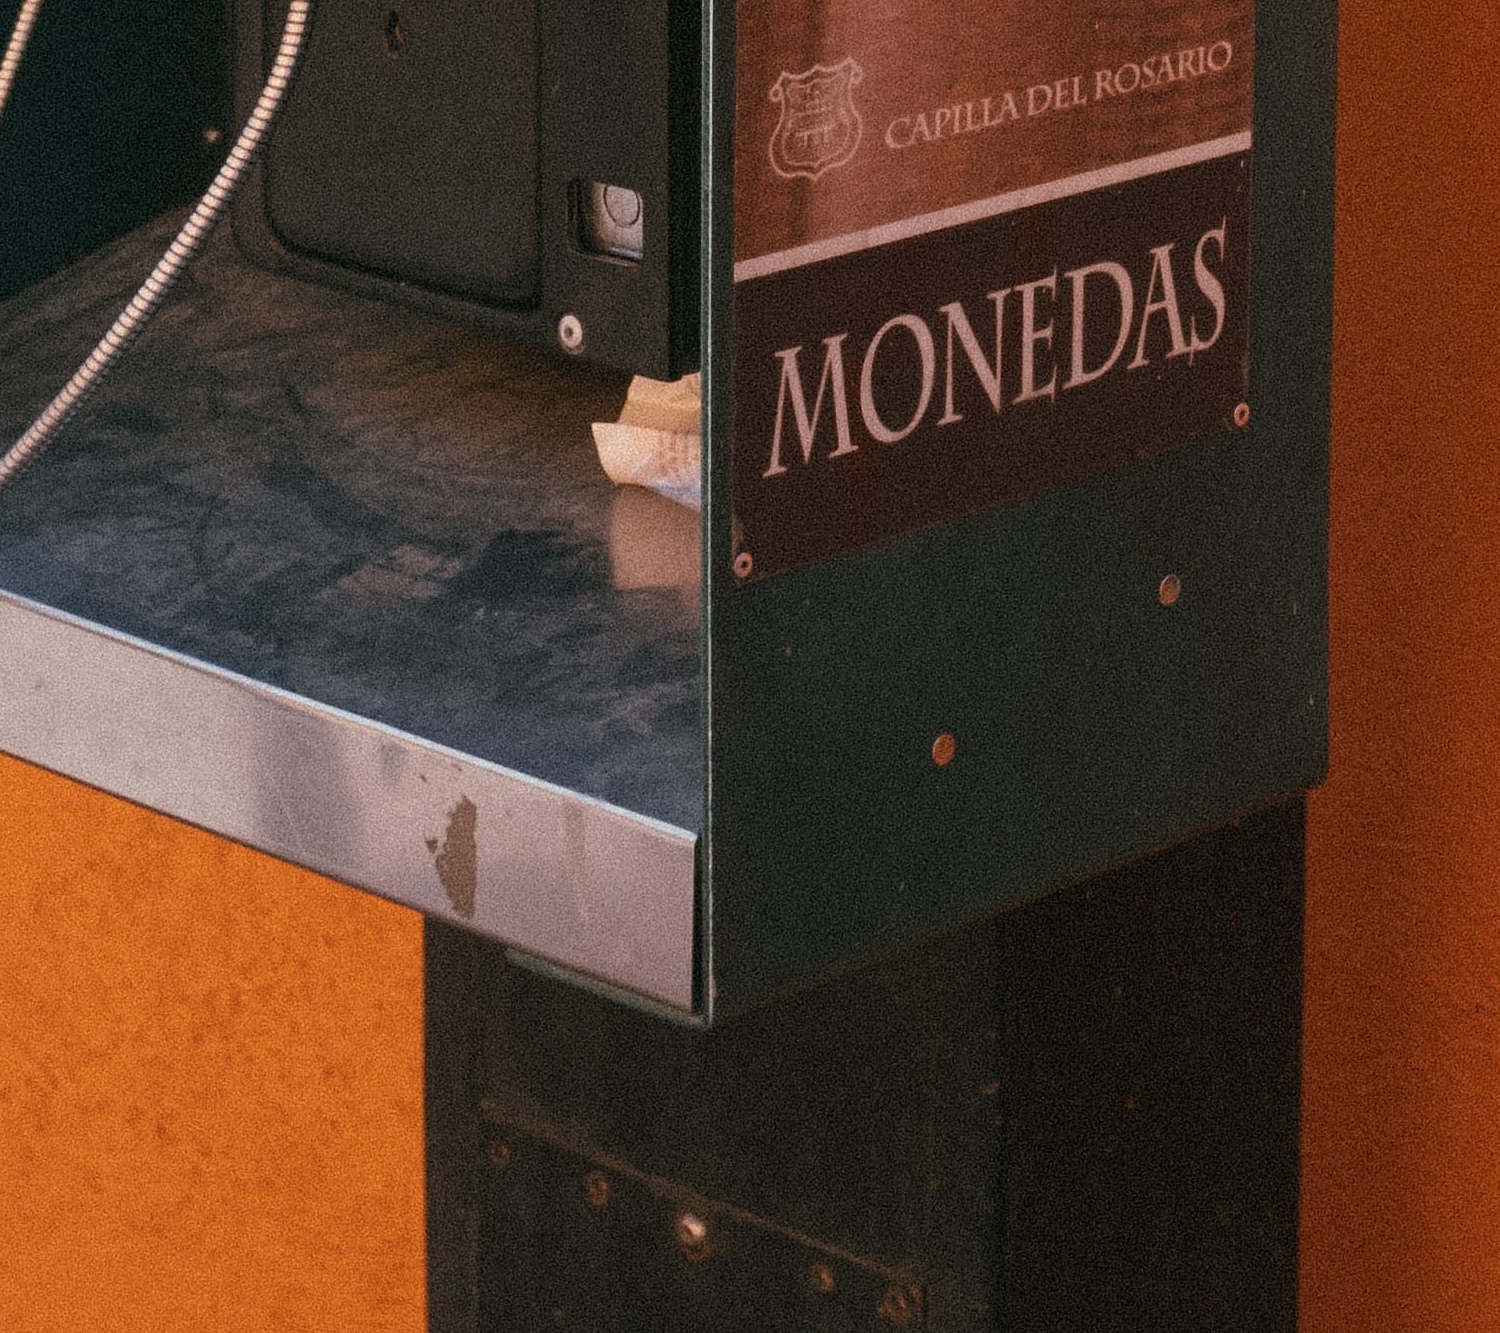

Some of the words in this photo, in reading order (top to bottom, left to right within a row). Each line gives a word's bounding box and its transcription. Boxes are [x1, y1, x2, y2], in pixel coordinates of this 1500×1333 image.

[884, 92, 1021, 149] CAPILLA
[1026, 76, 1087, 117] DEL
[1094, 40, 1234, 100] ROSARIO
[762, 216, 1228, 479] MONEDAS
